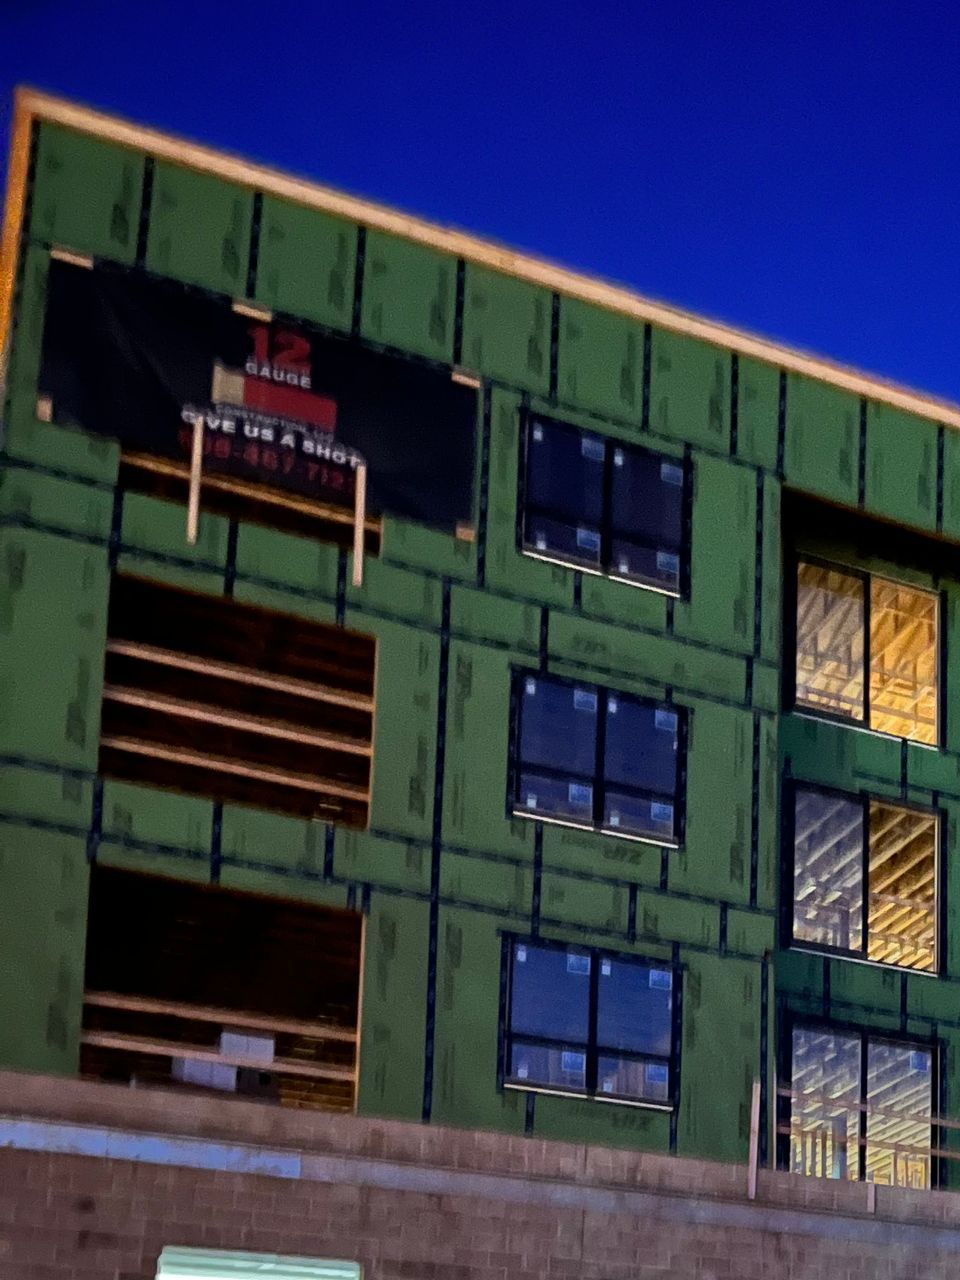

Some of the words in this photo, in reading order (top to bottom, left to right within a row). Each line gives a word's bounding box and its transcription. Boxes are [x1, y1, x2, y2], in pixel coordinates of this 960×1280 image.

[246, 324, 312, 371] 12
[245, 360, 312, 389] GAUGE
[180, 407, 236, 434] GVE
[243, 422, 275, 442] US
[280, 431, 296, 449] A
[302, 439, 365, 469] SHOT
